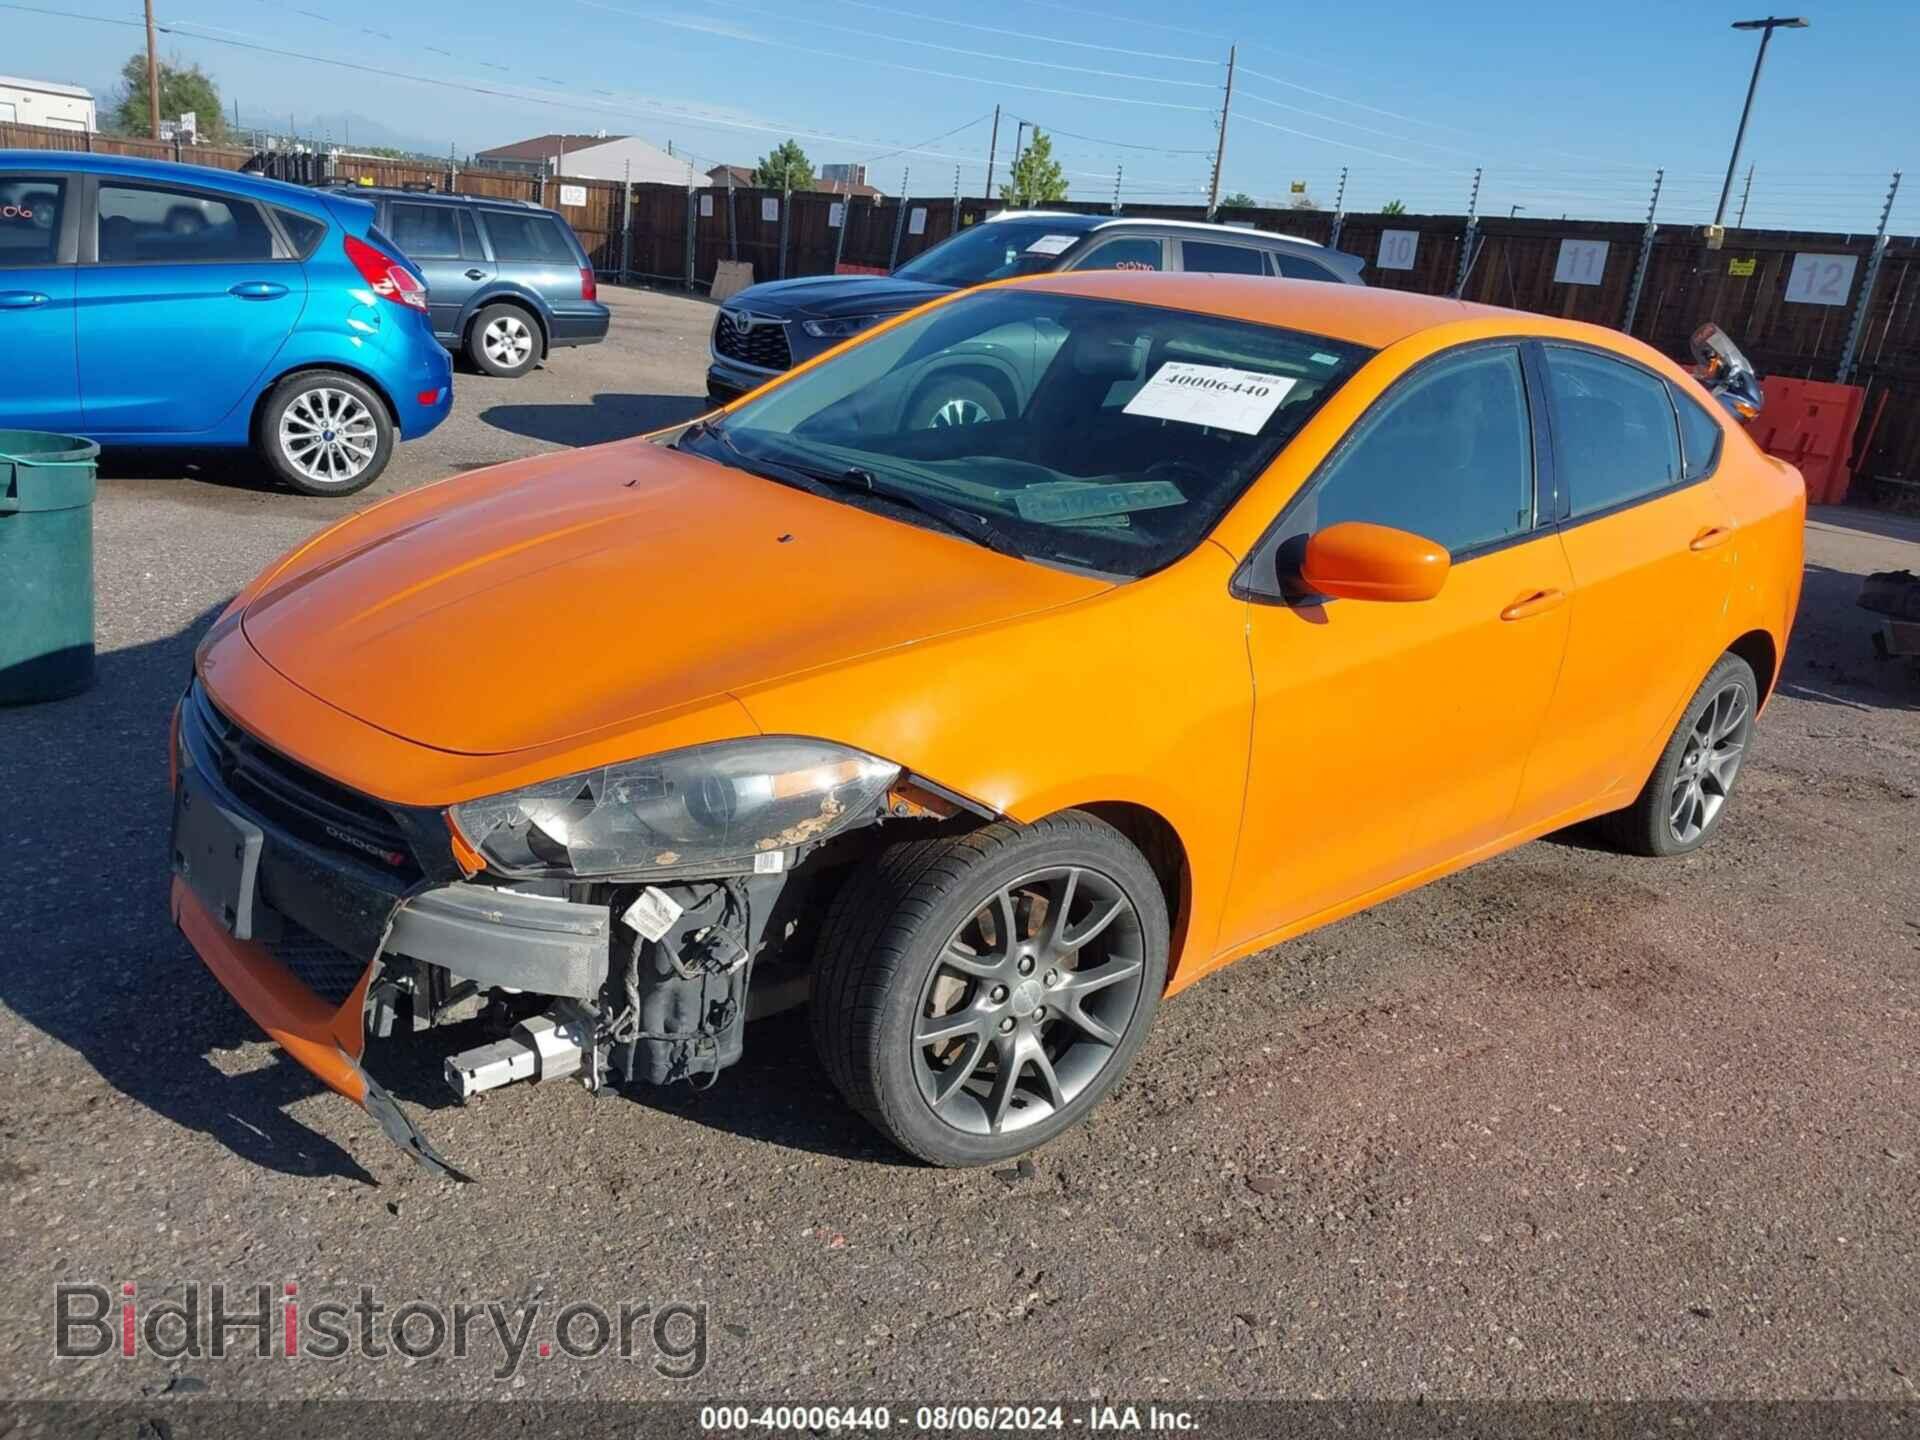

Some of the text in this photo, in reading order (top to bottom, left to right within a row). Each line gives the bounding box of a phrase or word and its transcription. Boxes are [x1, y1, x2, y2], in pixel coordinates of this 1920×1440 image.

[0, 205, 33, 218] 06
[1385, 236, 1411, 256] 10
[1567, 246, 1597, 273] 11
[1801, 261, 1844, 295] 12
[1165, 374, 1269, 398] 40006440
